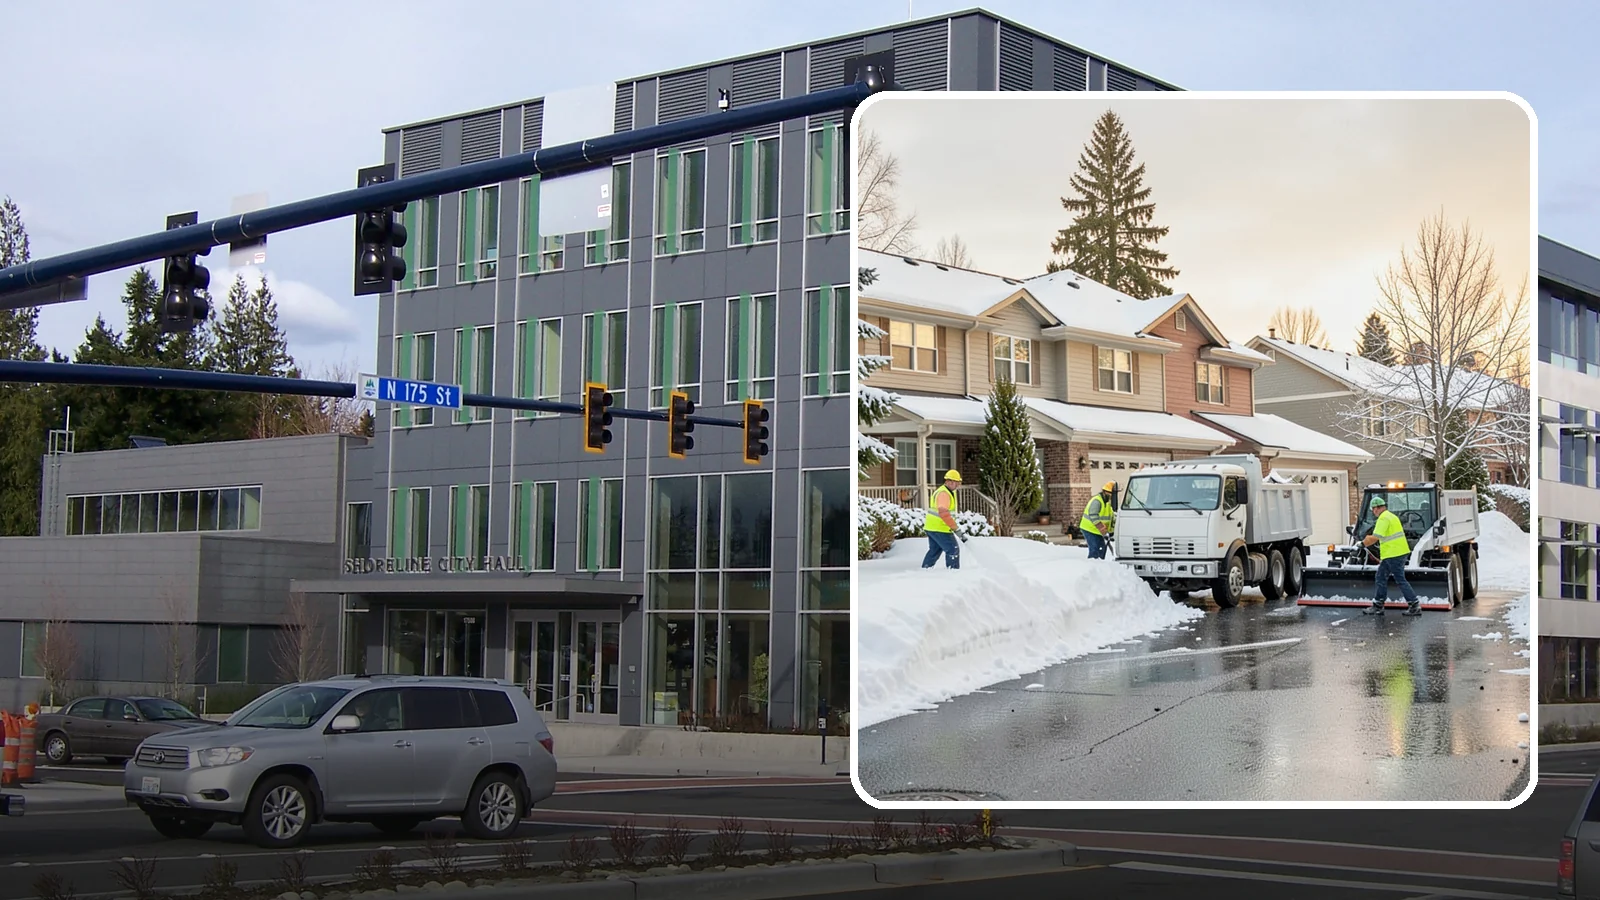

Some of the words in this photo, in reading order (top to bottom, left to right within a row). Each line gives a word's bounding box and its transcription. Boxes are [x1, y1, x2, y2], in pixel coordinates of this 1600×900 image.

[387, 380, 396, 400] N
[405, 382, 428, 403] 175
[436, 386, 451, 406] St
[344, 556, 432, 574] SHORELINE
[438, 556, 475, 573] CITY
[484, 555, 526, 572] HALL
